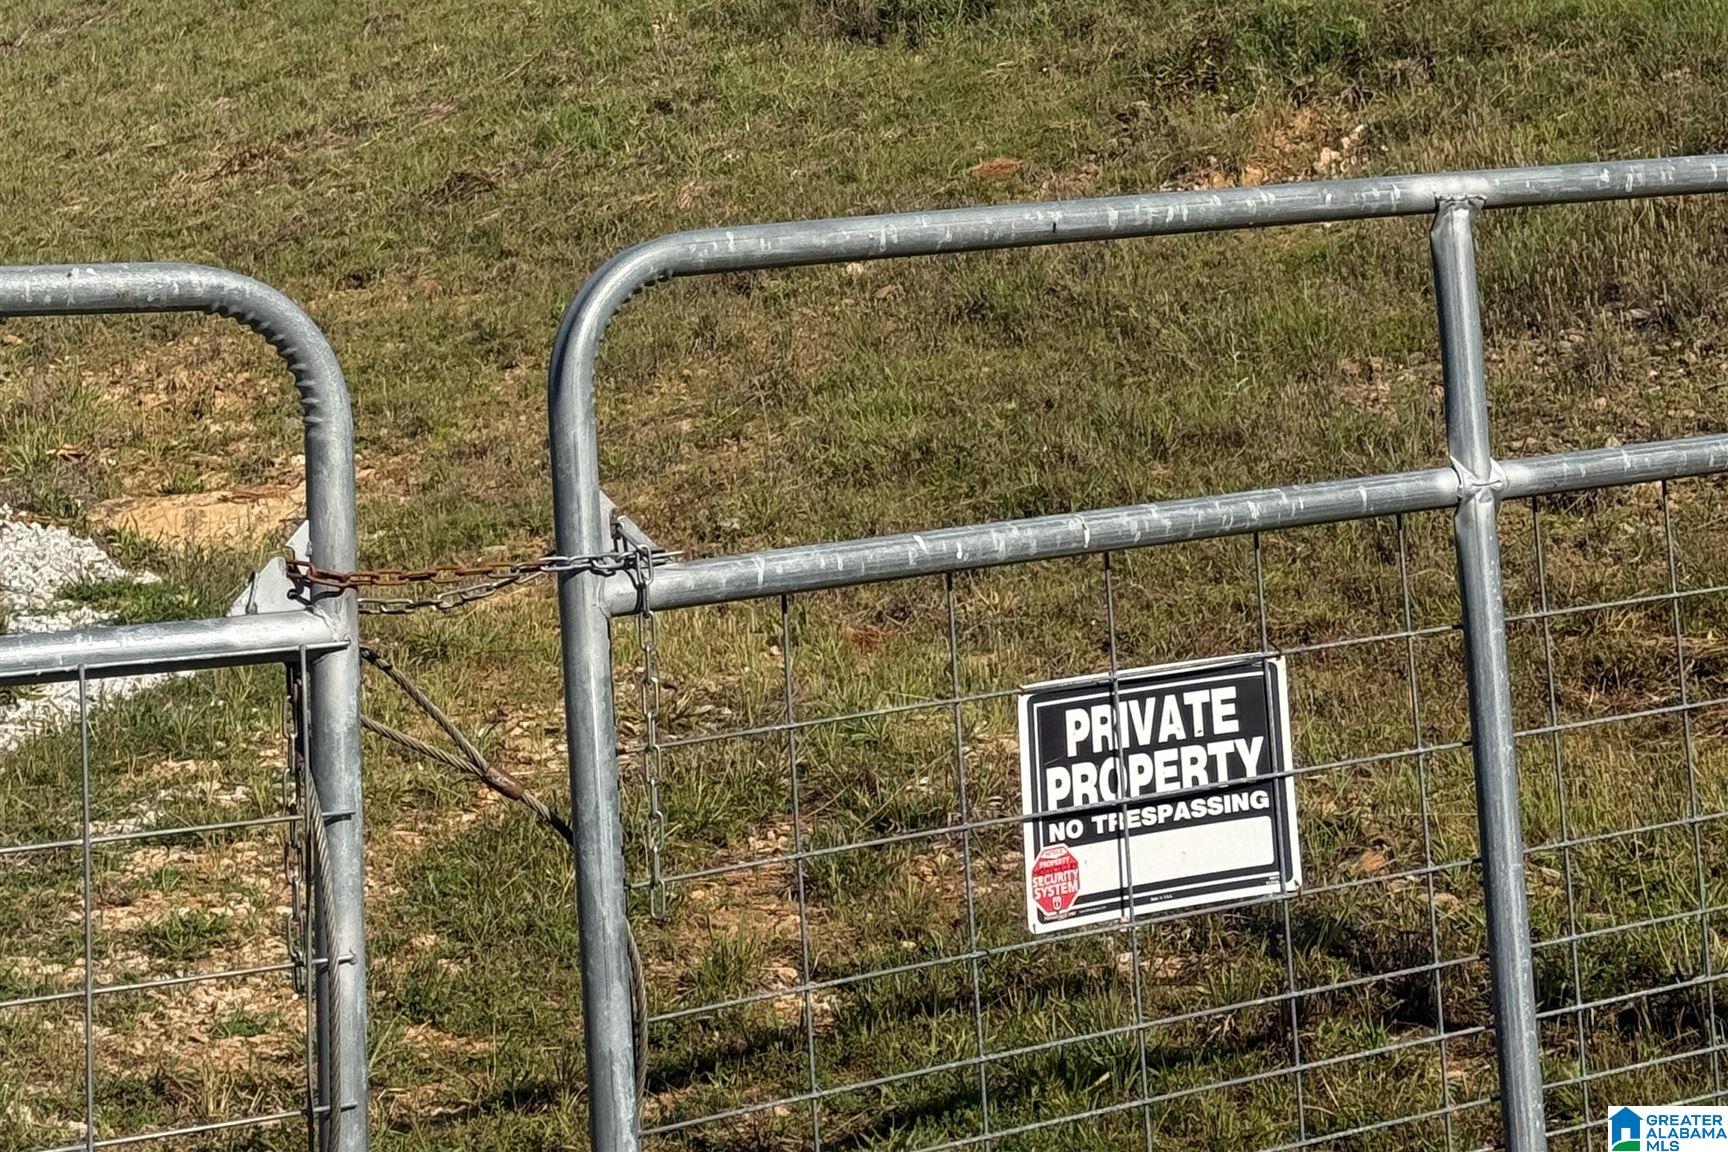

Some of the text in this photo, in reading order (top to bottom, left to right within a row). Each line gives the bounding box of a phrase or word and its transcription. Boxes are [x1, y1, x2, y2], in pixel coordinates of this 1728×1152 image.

[1065, 686, 1240, 757] PRIVATE
[1046, 736, 1264, 811] PROPERTY
[1048, 790, 1270, 843] NO TRESPASSING
[1032, 869, 1078, 888] SECURITY
[1034, 880, 1079, 900] SYSTEM
